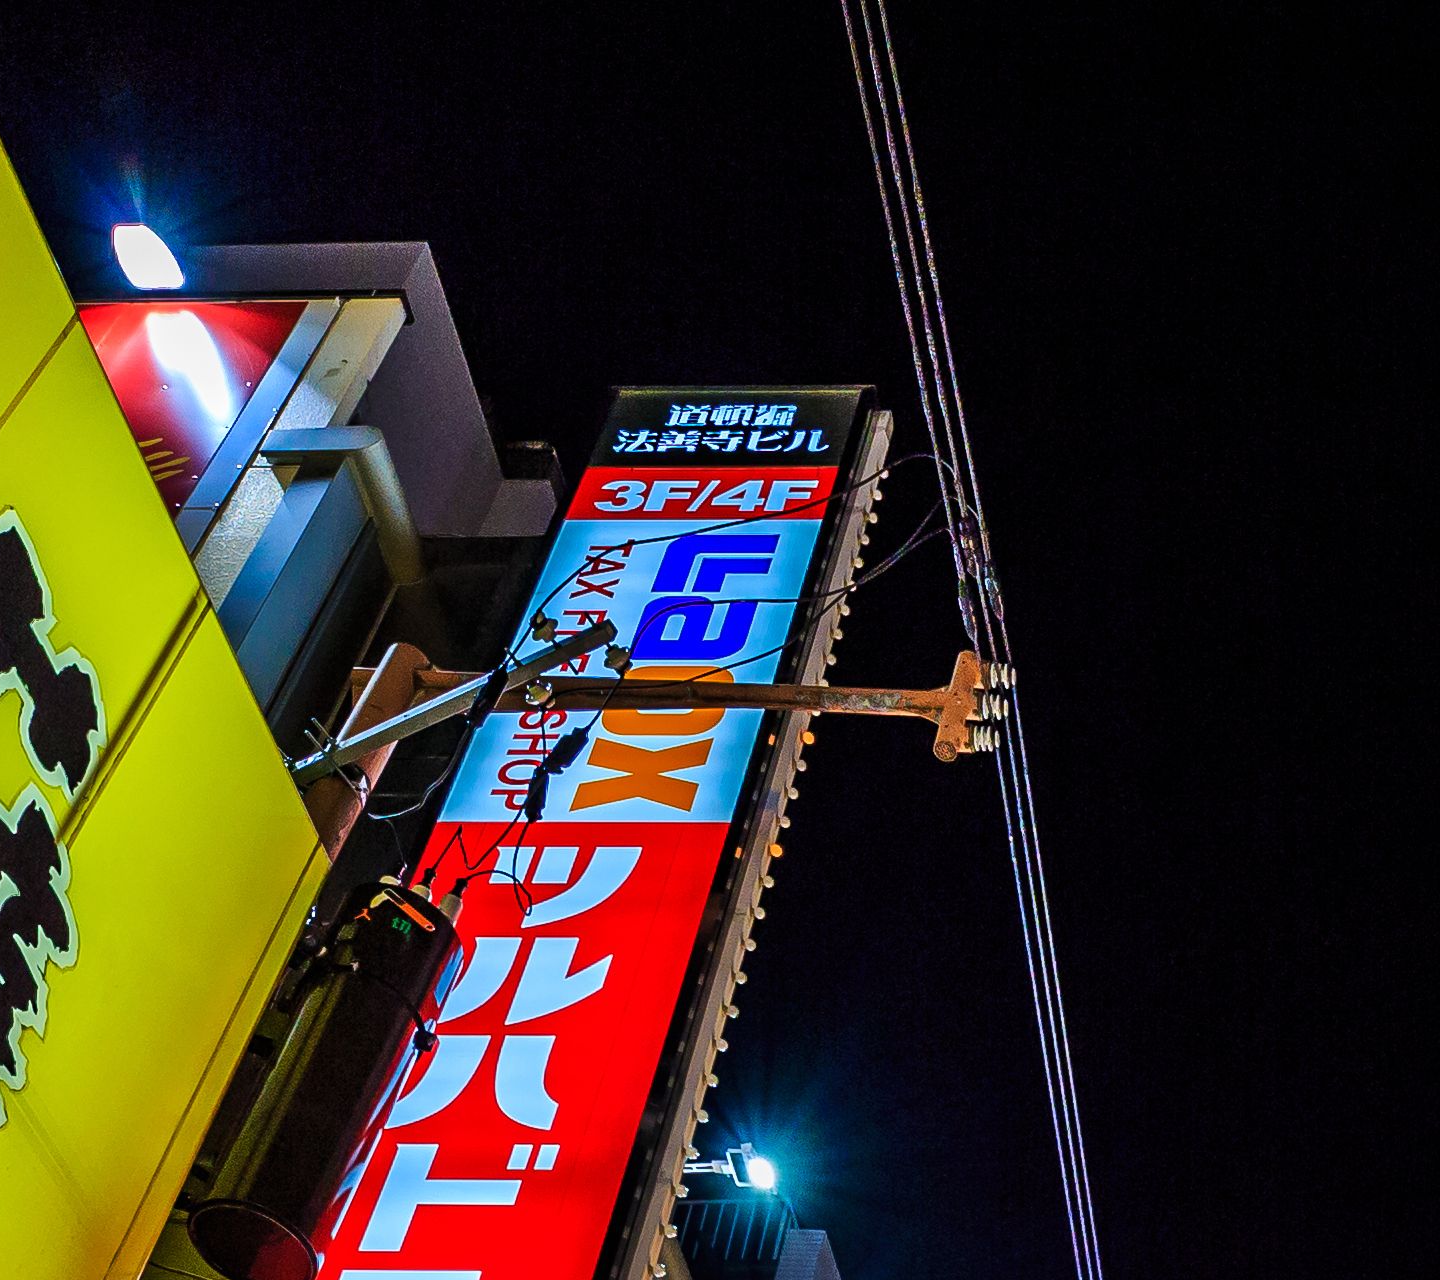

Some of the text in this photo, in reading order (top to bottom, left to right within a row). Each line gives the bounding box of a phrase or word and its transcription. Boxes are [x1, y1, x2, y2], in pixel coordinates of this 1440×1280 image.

[665, 405, 798, 427] 道頓堀
[612, 430, 830, 454] 法善寺ビル
[595, 480, 820, 513] 3F/4F
[491, 540, 634, 811] TAX SHOP
